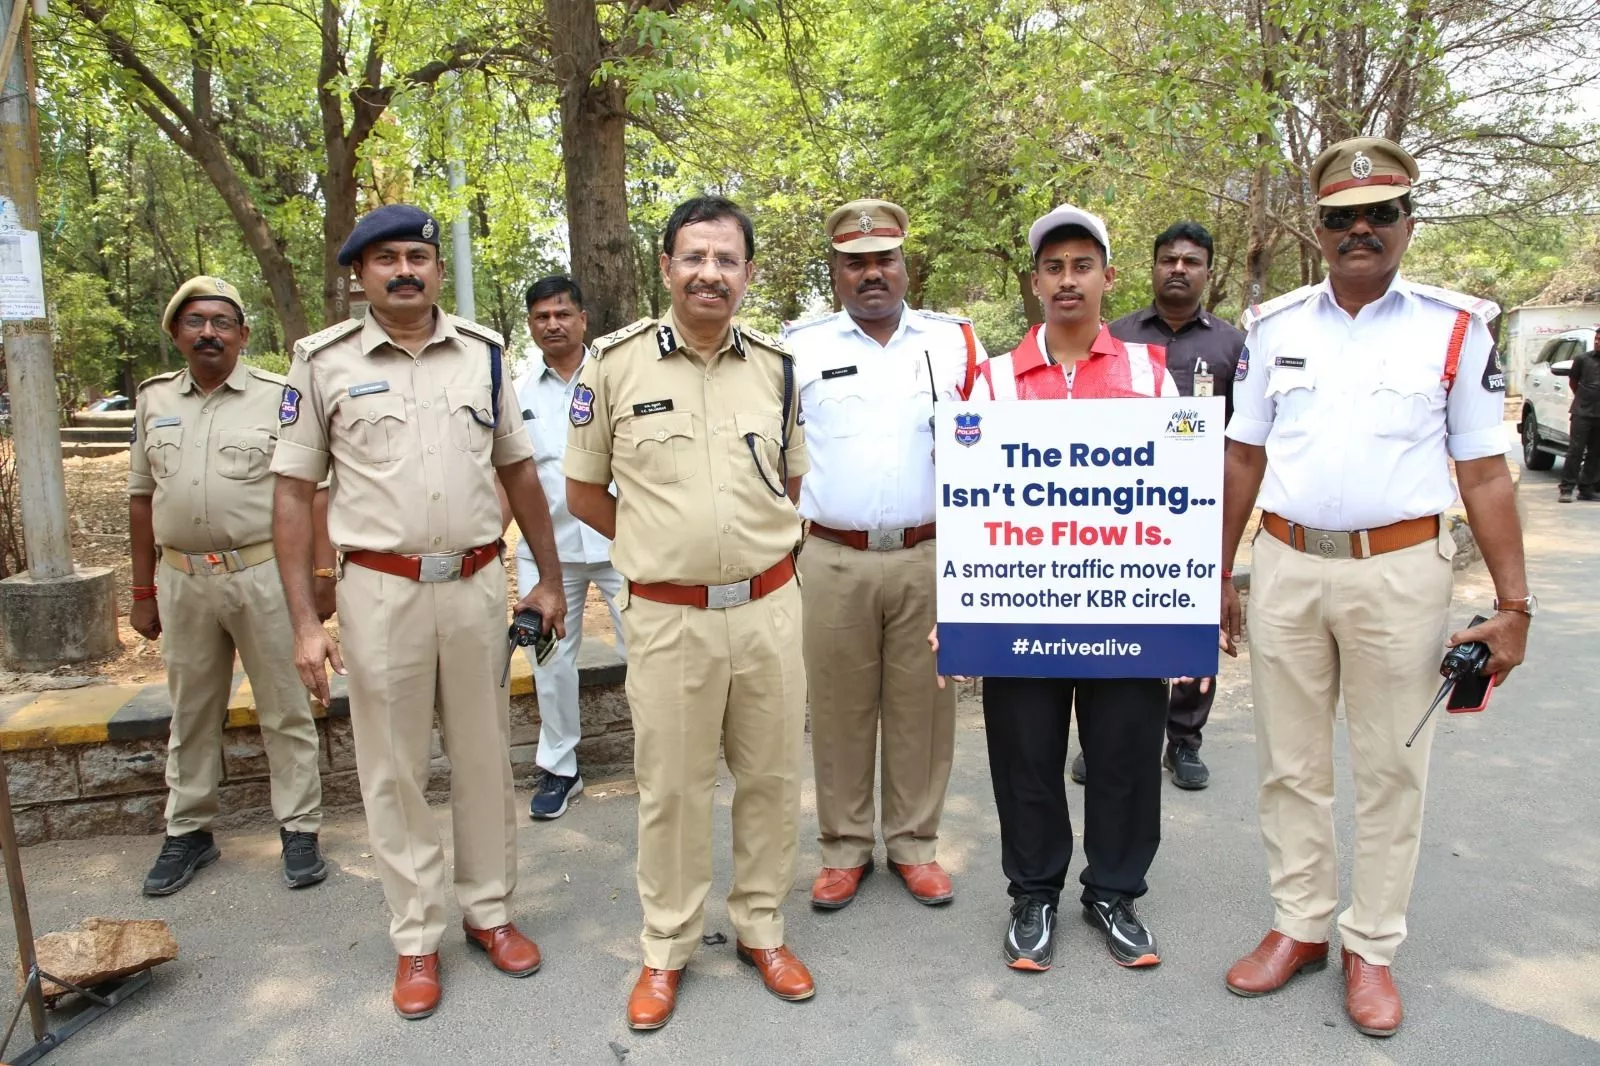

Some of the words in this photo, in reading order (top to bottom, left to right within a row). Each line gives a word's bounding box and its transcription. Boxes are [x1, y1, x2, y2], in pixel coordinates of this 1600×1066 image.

[957, 428, 980, 437] POLICE
[1001, 443, 1062, 468] The
[1069, 441, 1155, 468] Road
[942, 483, 1015, 508] Isn’t
[1022, 479, 1217, 516] Changing...
[984, 521, 1044, 546] The
[1051, 521, 1128, 546] Flow
[1135, 521, 1172, 546] Is.
[943, 560, 957, 578] A
[962, 561, 1046, 579] smarter
[1051, 559, 1115, 579] traffic
[1120, 563, 1181, 579] move
[1186, 558, 1216, 579] for
[960, 592, 974, 607] a
[980, 589, 1082, 608] smoother
[1087, 589, 1127, 608] KBR
[1132, 588, 1196, 608] circle.
[1011, 638, 1142, 657] #Arrivealive
